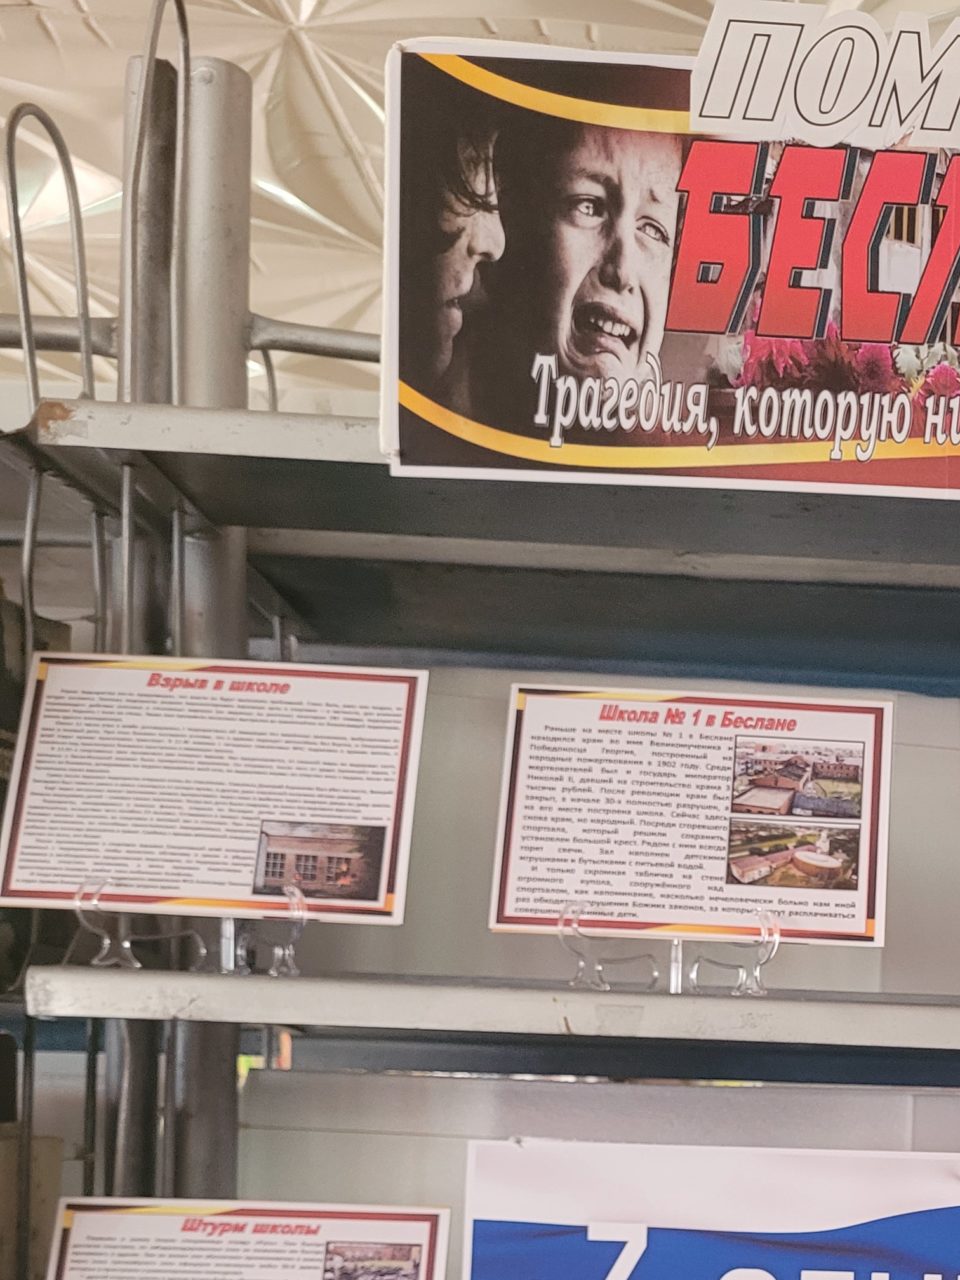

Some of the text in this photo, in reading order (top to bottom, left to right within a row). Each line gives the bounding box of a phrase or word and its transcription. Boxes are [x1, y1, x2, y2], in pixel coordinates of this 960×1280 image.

[531, 353, 719, 451] Трагедия,
[733, 386, 912, 461] которую
[147, 673, 291, 694] Взрыв в школе
[598, 704, 797, 731] Школа № 1 в Беслане
[181, 1216, 320, 1236] Штурм школы
